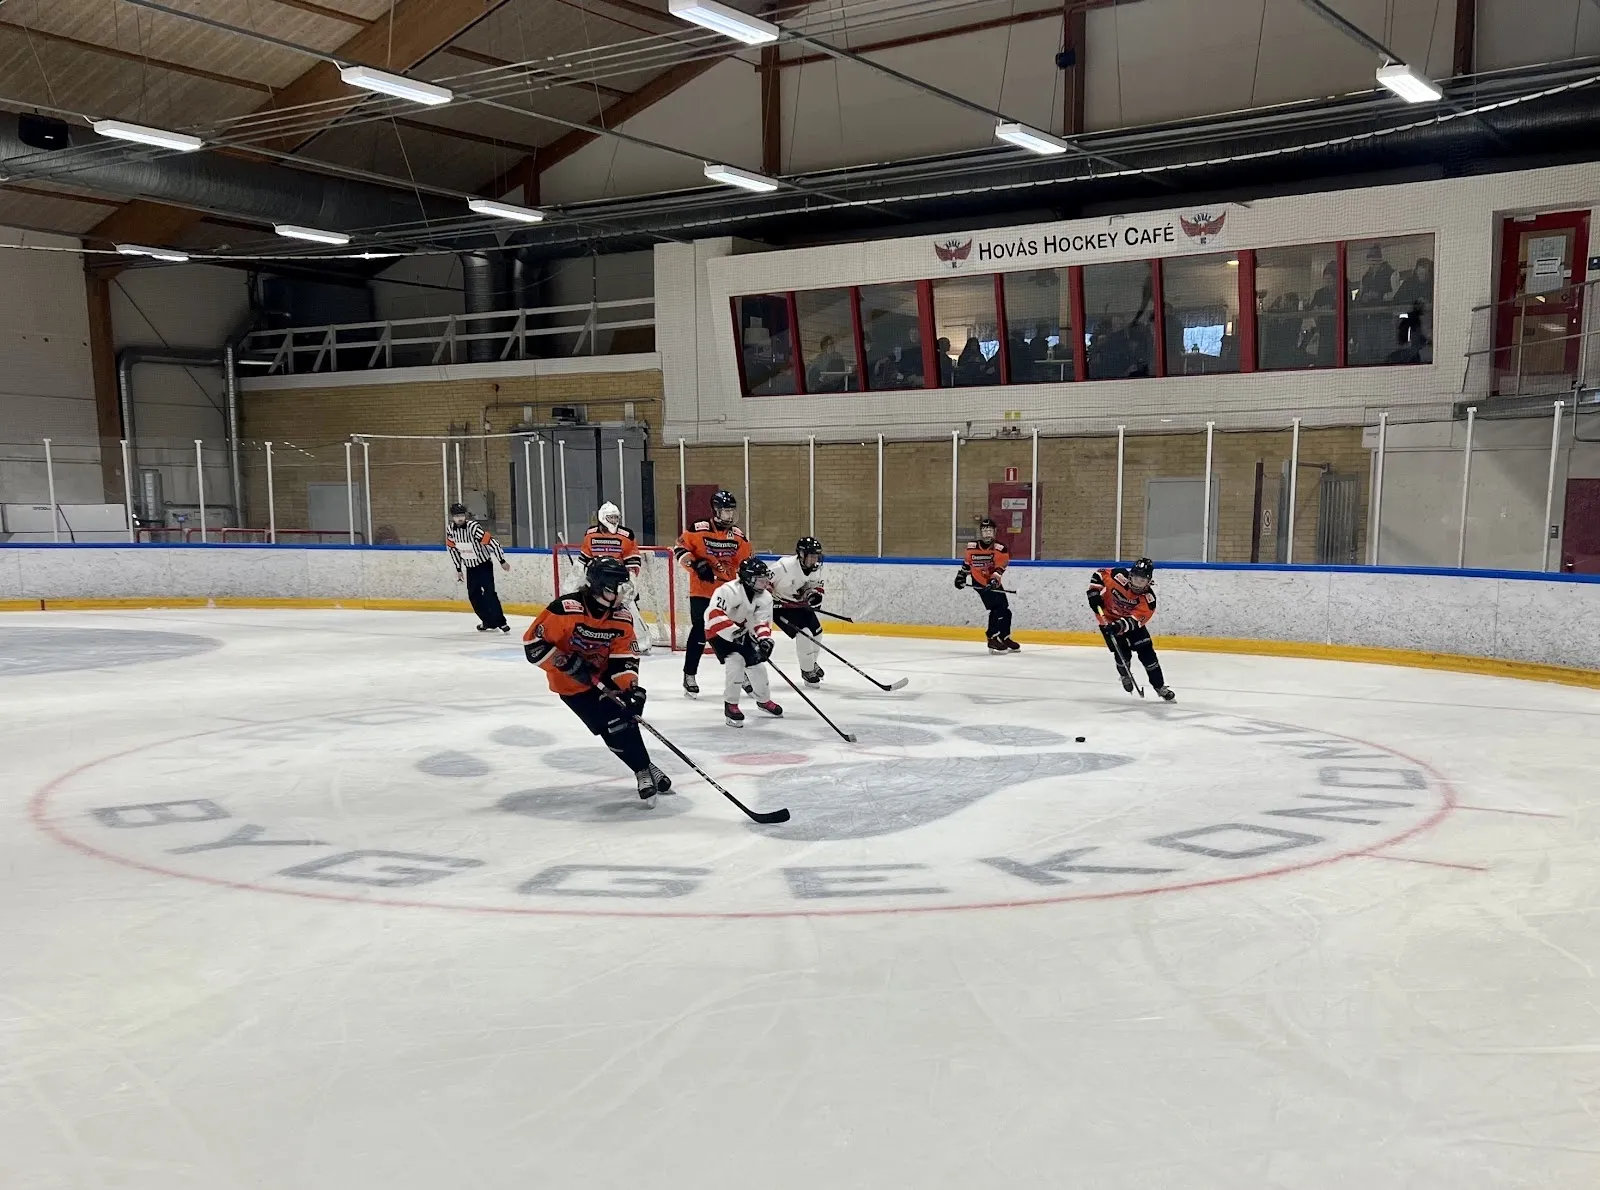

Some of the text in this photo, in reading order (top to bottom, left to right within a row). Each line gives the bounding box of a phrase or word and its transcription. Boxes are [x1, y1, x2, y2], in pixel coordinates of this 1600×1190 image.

[978, 237, 1038, 261] HOVÅS
[1044, 232, 1119, 254] HOCKEY
[1124, 223, 1175, 246] CAFÉ
